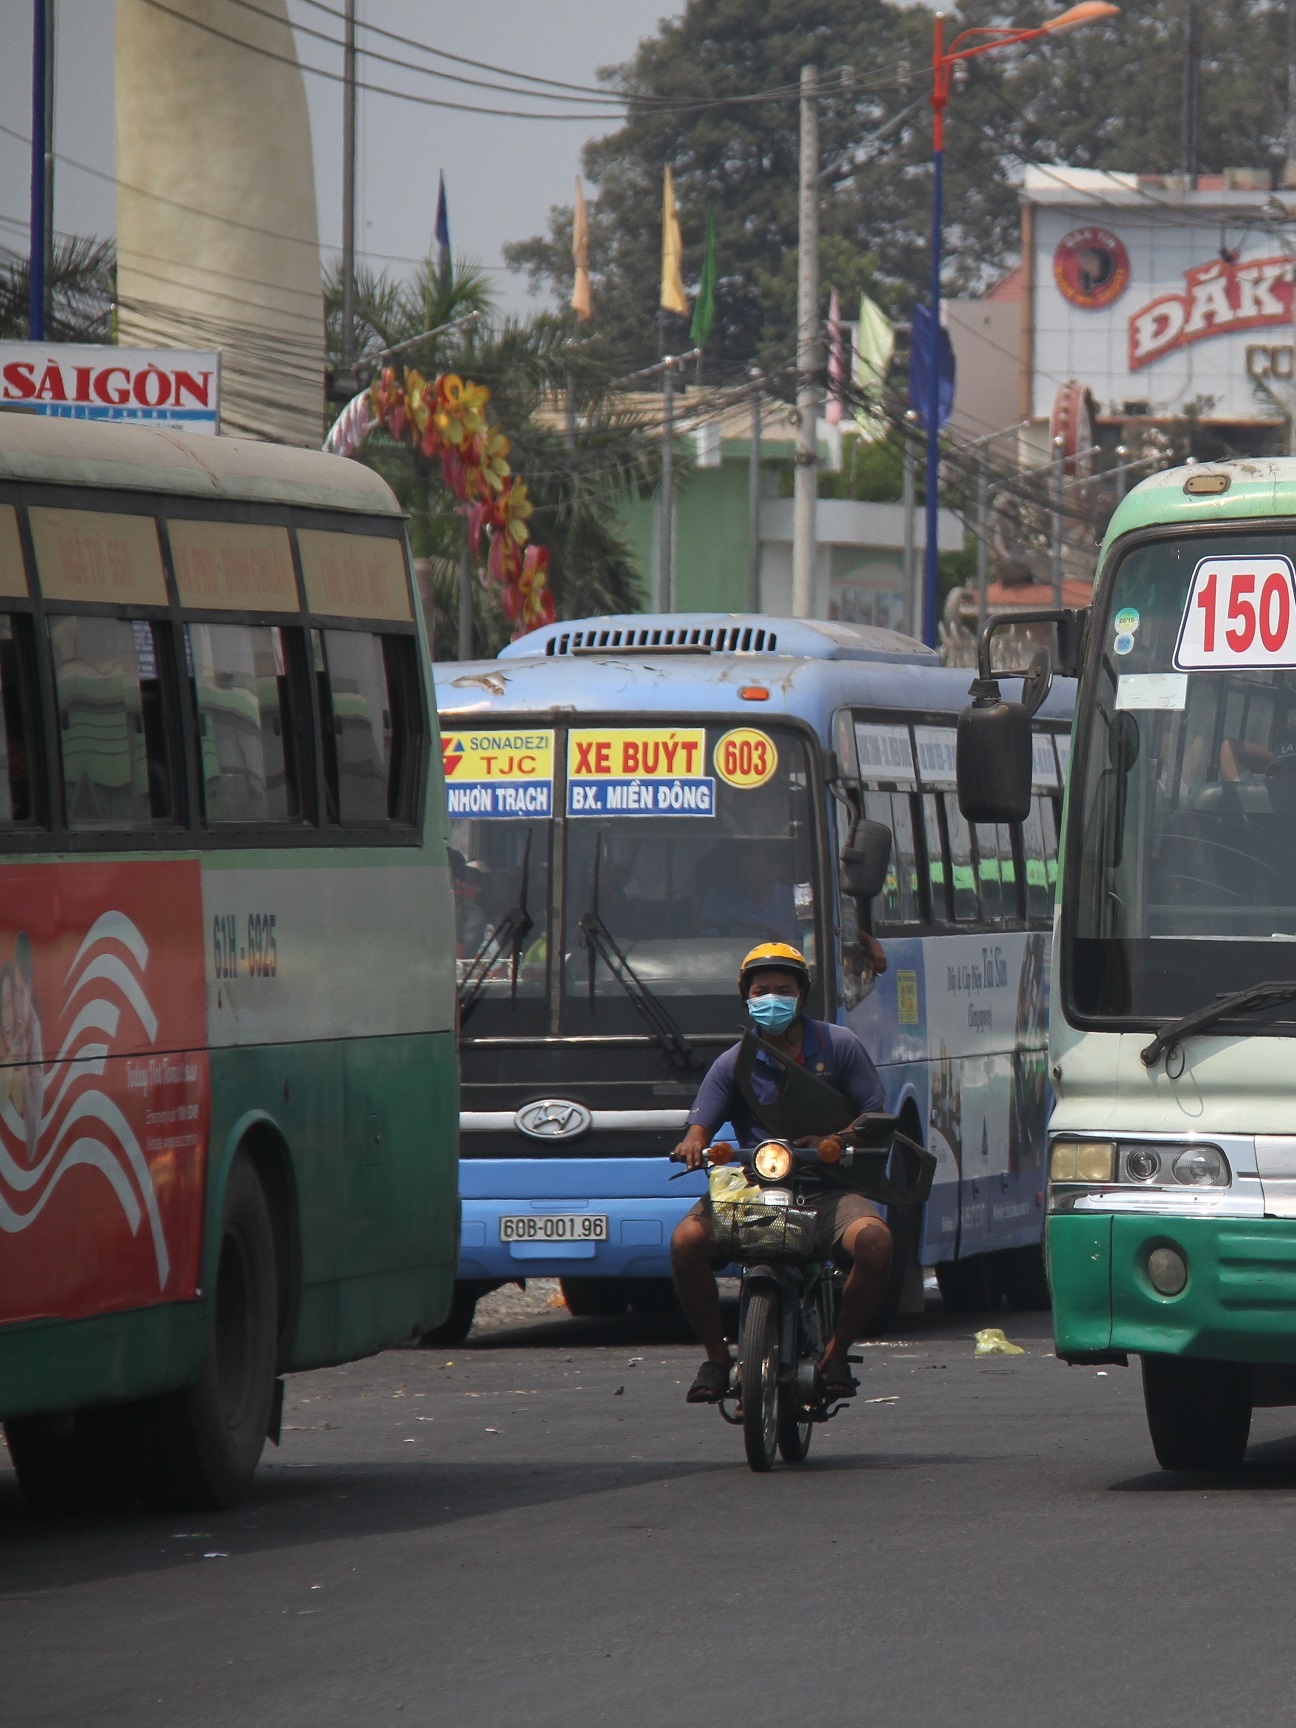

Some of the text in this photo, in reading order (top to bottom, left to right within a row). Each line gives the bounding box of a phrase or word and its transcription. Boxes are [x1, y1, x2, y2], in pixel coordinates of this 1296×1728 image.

[2, 358, 213, 407] SÀIGÒN
[1198, 573, 1290, 653] 150
[470, 736, 549, 751] SONADEZI
[574, 733, 698, 774] XE BUÝT
[724, 739, 767, 776] 603
[480, 755, 537, 775] TJC
[448, 785, 548, 816] NHƠN TRẠCH
[572, 779, 710, 810] BX. MIỀN ĐÔNG
[503, 1218, 604, 1238] 60B-001.96
